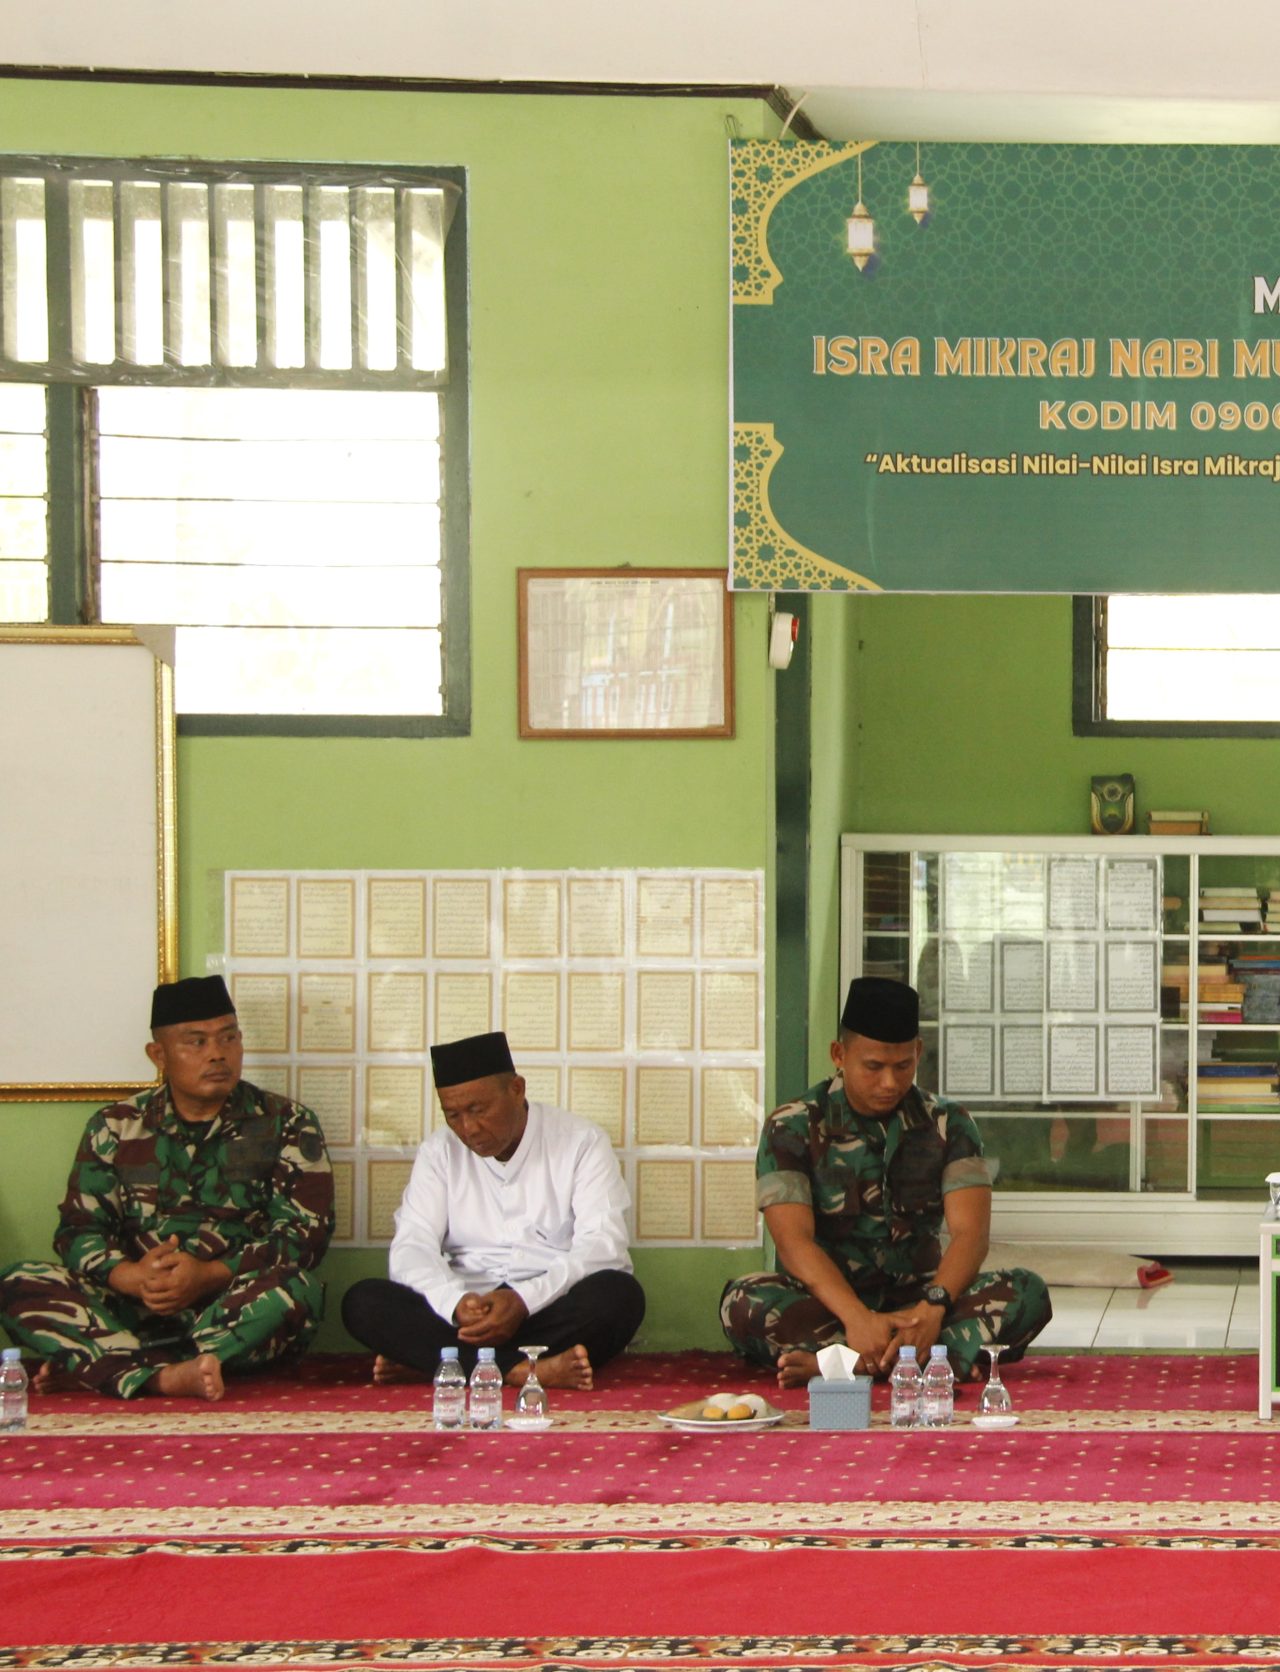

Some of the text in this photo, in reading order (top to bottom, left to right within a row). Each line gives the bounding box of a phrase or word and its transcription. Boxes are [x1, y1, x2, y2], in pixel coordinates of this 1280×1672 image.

[812, 335, 921, 376] ISRA
[934, 336, 1096, 378] MIKRAJ
[1109, 338, 1219, 378] NABI
[1038, 400, 1178, 431] KODIM
[864, 451, 1018, 475] “Aktualisasi
[1022, 453, 1148, 476] Nilai-Nilai
[1152, 455, 1199, 476] Isra
